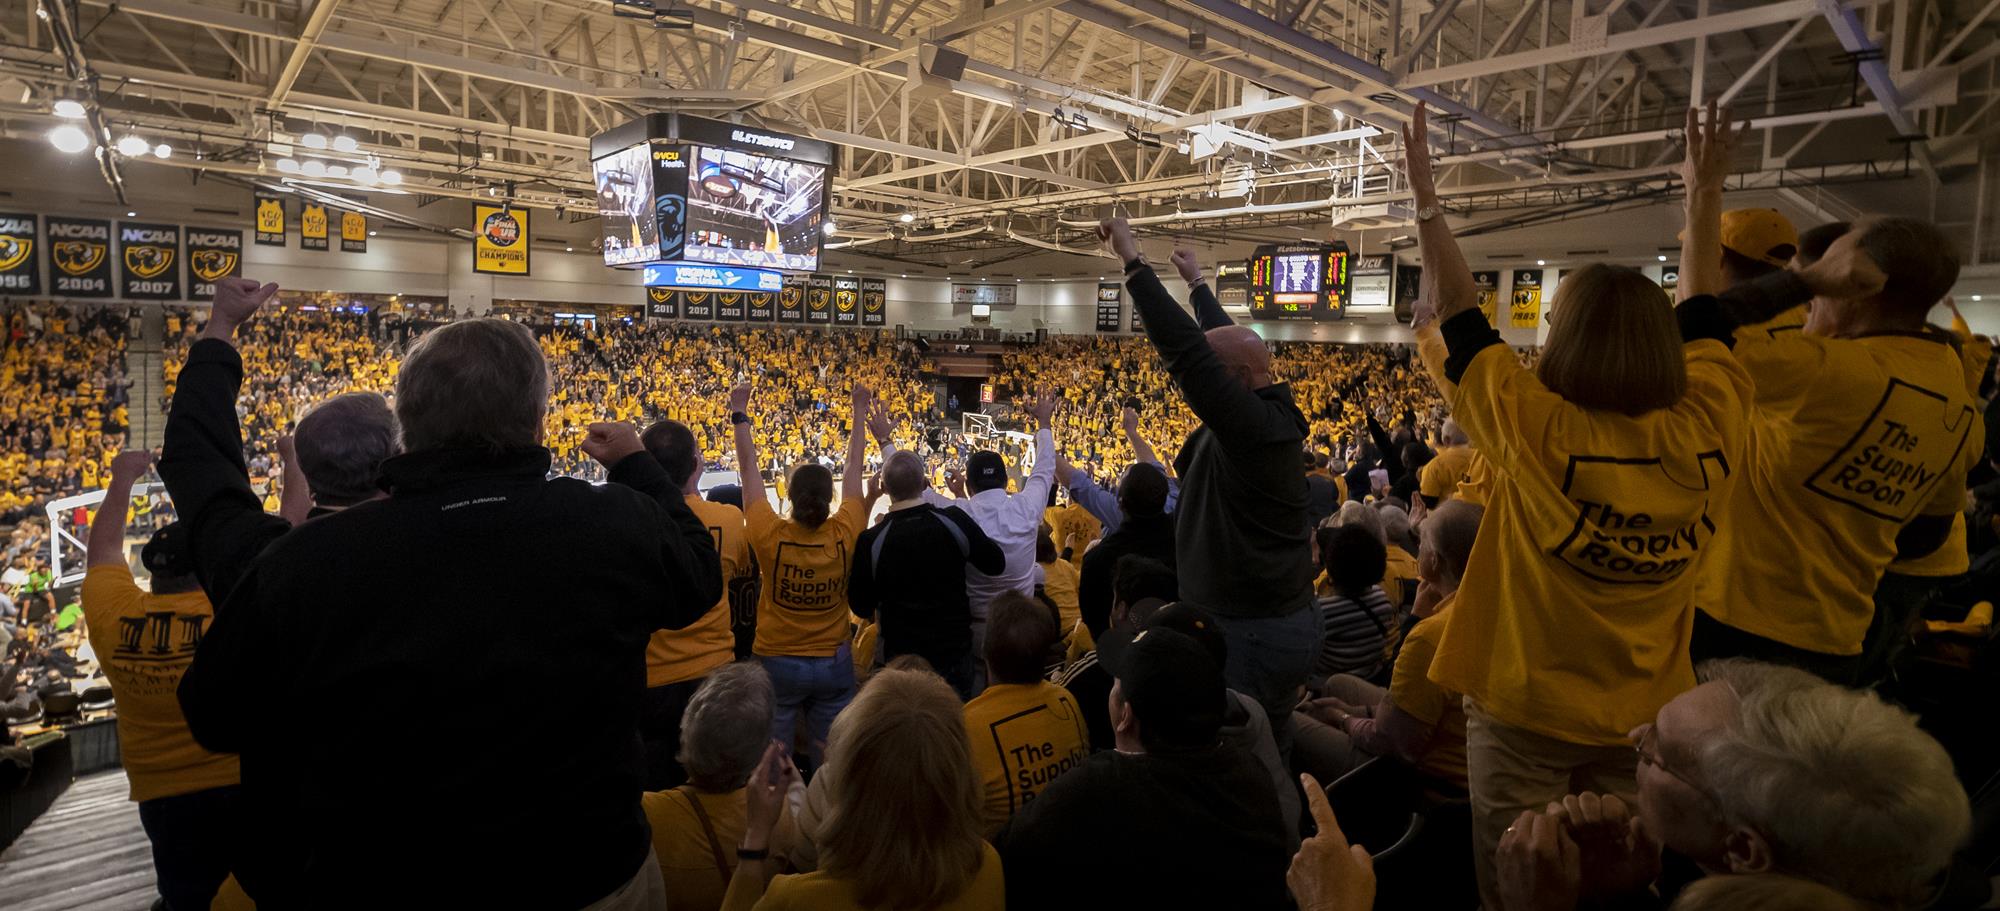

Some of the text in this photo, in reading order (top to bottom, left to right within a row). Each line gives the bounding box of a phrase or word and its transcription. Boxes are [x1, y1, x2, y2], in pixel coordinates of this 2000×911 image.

[660, 151, 679, 160] VCU
[49, 223, 107, 239] NCAA
[121, 228, 177, 244] NCAA
[188, 232, 239, 248] NCAA
[480, 250, 525, 261] CHAMPIONS
[57, 276, 105, 291] 2004
[129, 281, 174, 294] 2007
[808, 279, 830, 288] NCAA
[836, 280, 858, 290] NCAA
[863, 282, 885, 291] NCAA
[653, 304, 673, 314] 2011
[688, 306, 709, 315] 2012
[721, 307, 741, 317] 2013
[752, 309, 770, 318] 2014
[782, 310, 801, 319] 2015
[811, 311, 828, 320] 2016
[838, 312, 855, 321] 2017
[1513, 312, 1536, 321] 1985
[1878, 420, 1918, 452] The
[441, 496, 507, 511] UNDER ARMOUR
[1576, 499, 1653, 528] The
[1578, 542, 1690, 575] Room
[783, 563, 815, 579] The
[781, 578, 840, 596] Supply
[780, 590, 831, 605] Room
[1010, 742, 1054, 768] The
